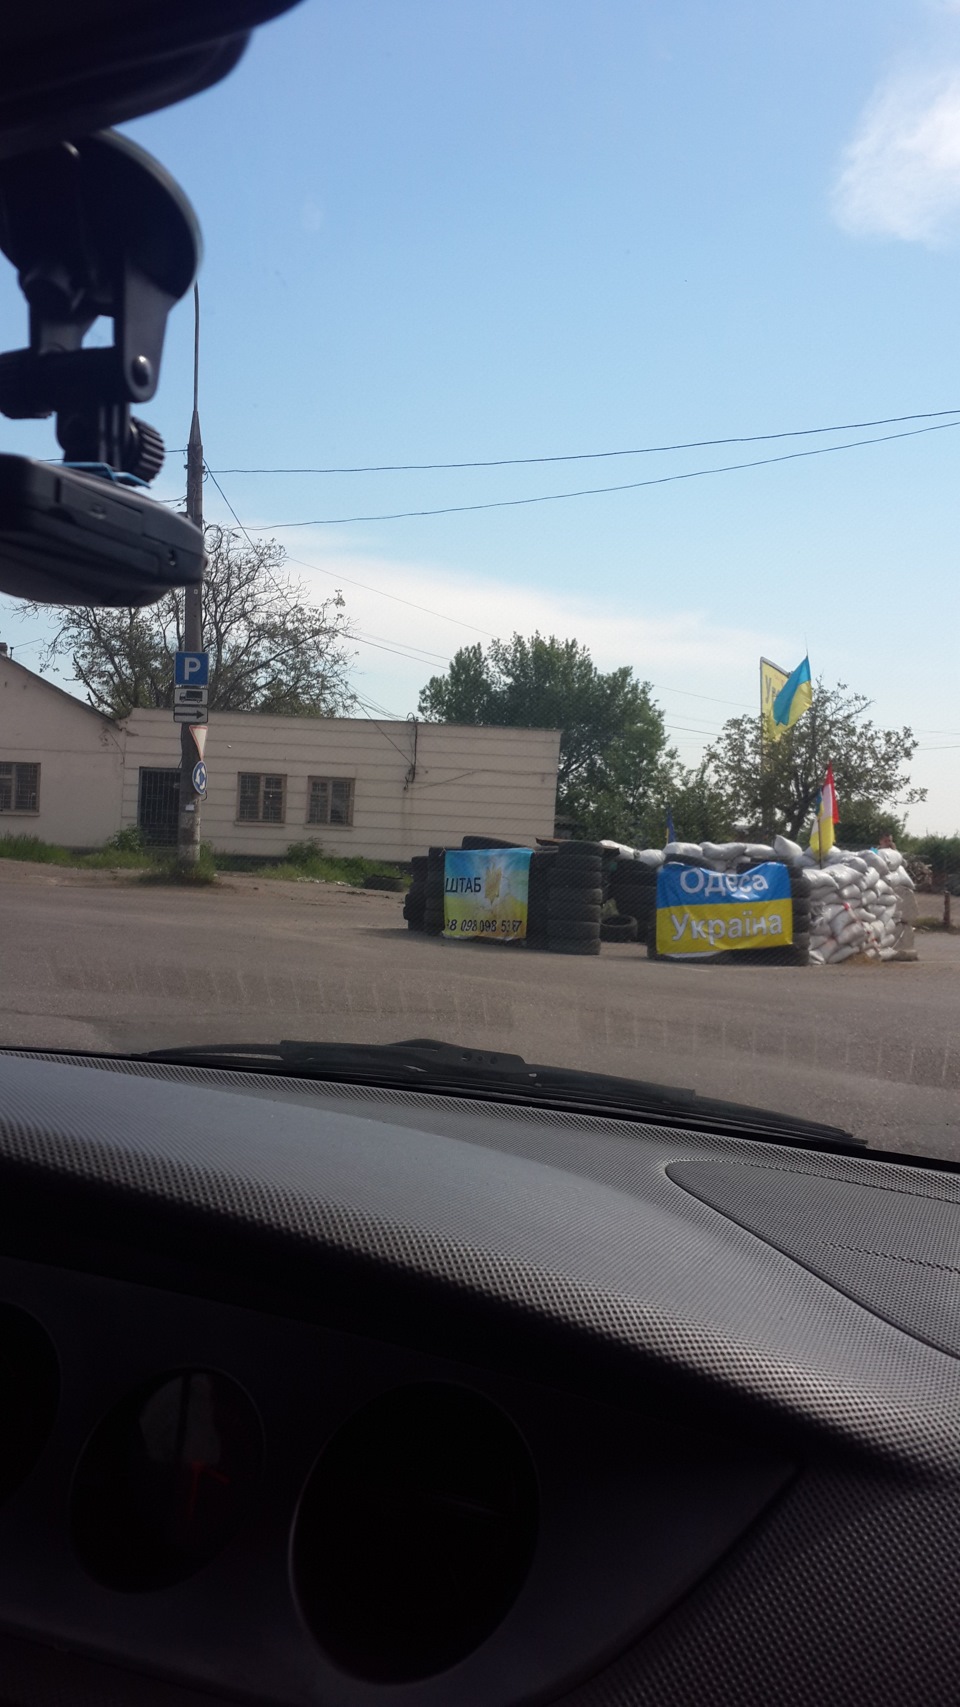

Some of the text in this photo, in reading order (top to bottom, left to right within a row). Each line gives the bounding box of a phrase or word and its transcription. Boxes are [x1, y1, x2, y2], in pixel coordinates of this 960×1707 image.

[184, 657, 201, 681] P
[445, 877, 482, 893] ШТАБ
[679, 867, 769, 897] Одеса
[671, 910, 783, 945] Україна
